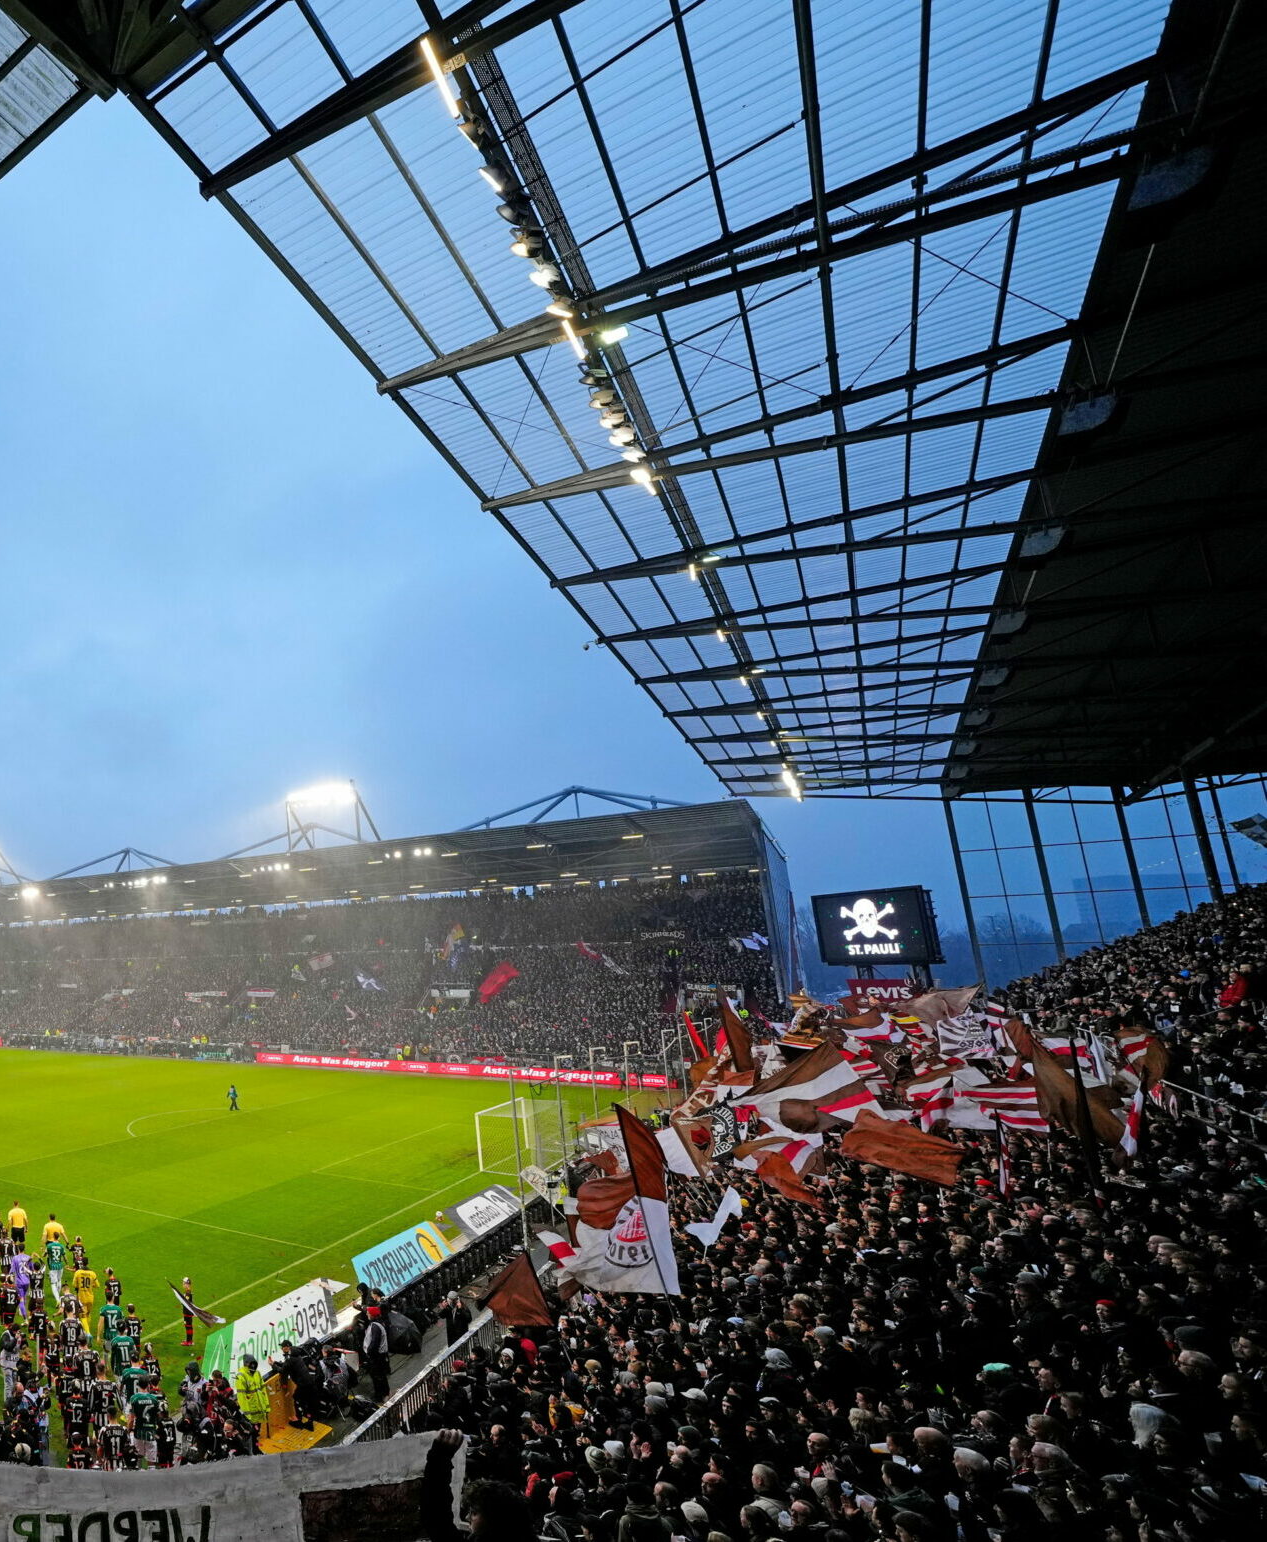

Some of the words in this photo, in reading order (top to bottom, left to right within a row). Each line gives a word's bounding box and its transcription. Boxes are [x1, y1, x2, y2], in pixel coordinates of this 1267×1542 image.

[848, 944, 863, 956] ST.
[864, 943, 901, 955] PAULI
[293, 1055, 319, 1064] Astra.
[321, 1056, 341, 1065] Was
[342, 1058, 389, 1069] dagegen?
[80, 1277, 91, 1289] 30
[67, 1327, 76, 1342] 19
[83, 1360, 90, 1376] 8
